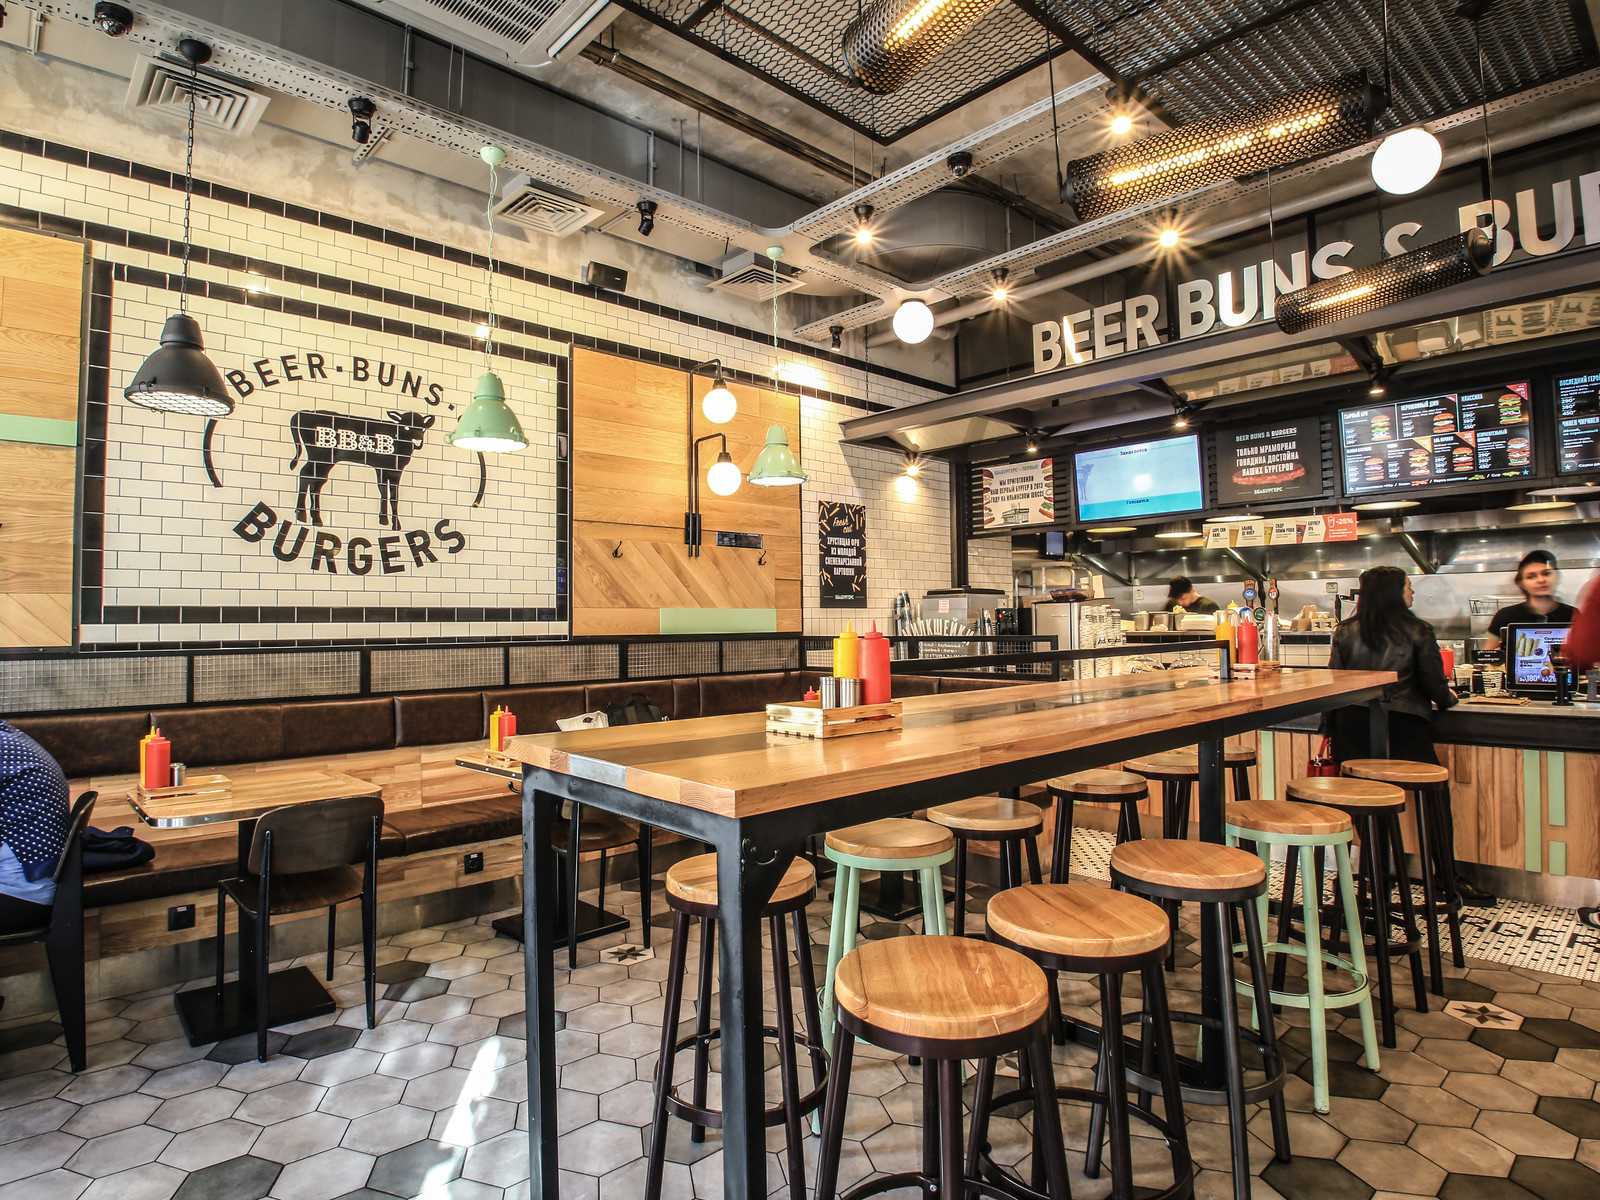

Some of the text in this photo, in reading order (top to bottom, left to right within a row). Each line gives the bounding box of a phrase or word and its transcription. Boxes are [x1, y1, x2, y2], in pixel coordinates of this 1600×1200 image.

[1032, 294, 1161, 373] BEER
[1178, 241, 1354, 339] BUNS
[226, 353, 328, 398] BEER
[1250, 432, 1265, 440] BUNS
[1271, 427, 1297, 437] BURGERS
[316, 426, 394, 454] BB&B
[1236, 441, 1296, 457] ТОЛЬКО МРАМОРНАЯ
[1236, 451, 1299, 467] ГОВЯДИНА ДОСТОЙНА
[1241, 462, 1293, 476] НАШИХ БУРГЕРОВ
[1006, 475, 1034, 485] ПРИГОТОВИЛИ
[990, 487, 998, 495] НАШ
[999, 485, 1014, 494] ПЕРВЫЙ
[1015, 484, 1029, 492] БУРГЕР
[1006, 492, 1030, 501] ИЛЬИНСКОМ
[1031, 490, 1044, 498] ШОССЕ
[833, 516, 849, 527] Fresh
[1335, 517, 1354, 525] -25%
[842, 525, 853, 534] cut
[232, 501, 465, 575] BURGERS
[851, 538, 860, 547] ФРИ
[830, 547, 836, 556] ИЗ
